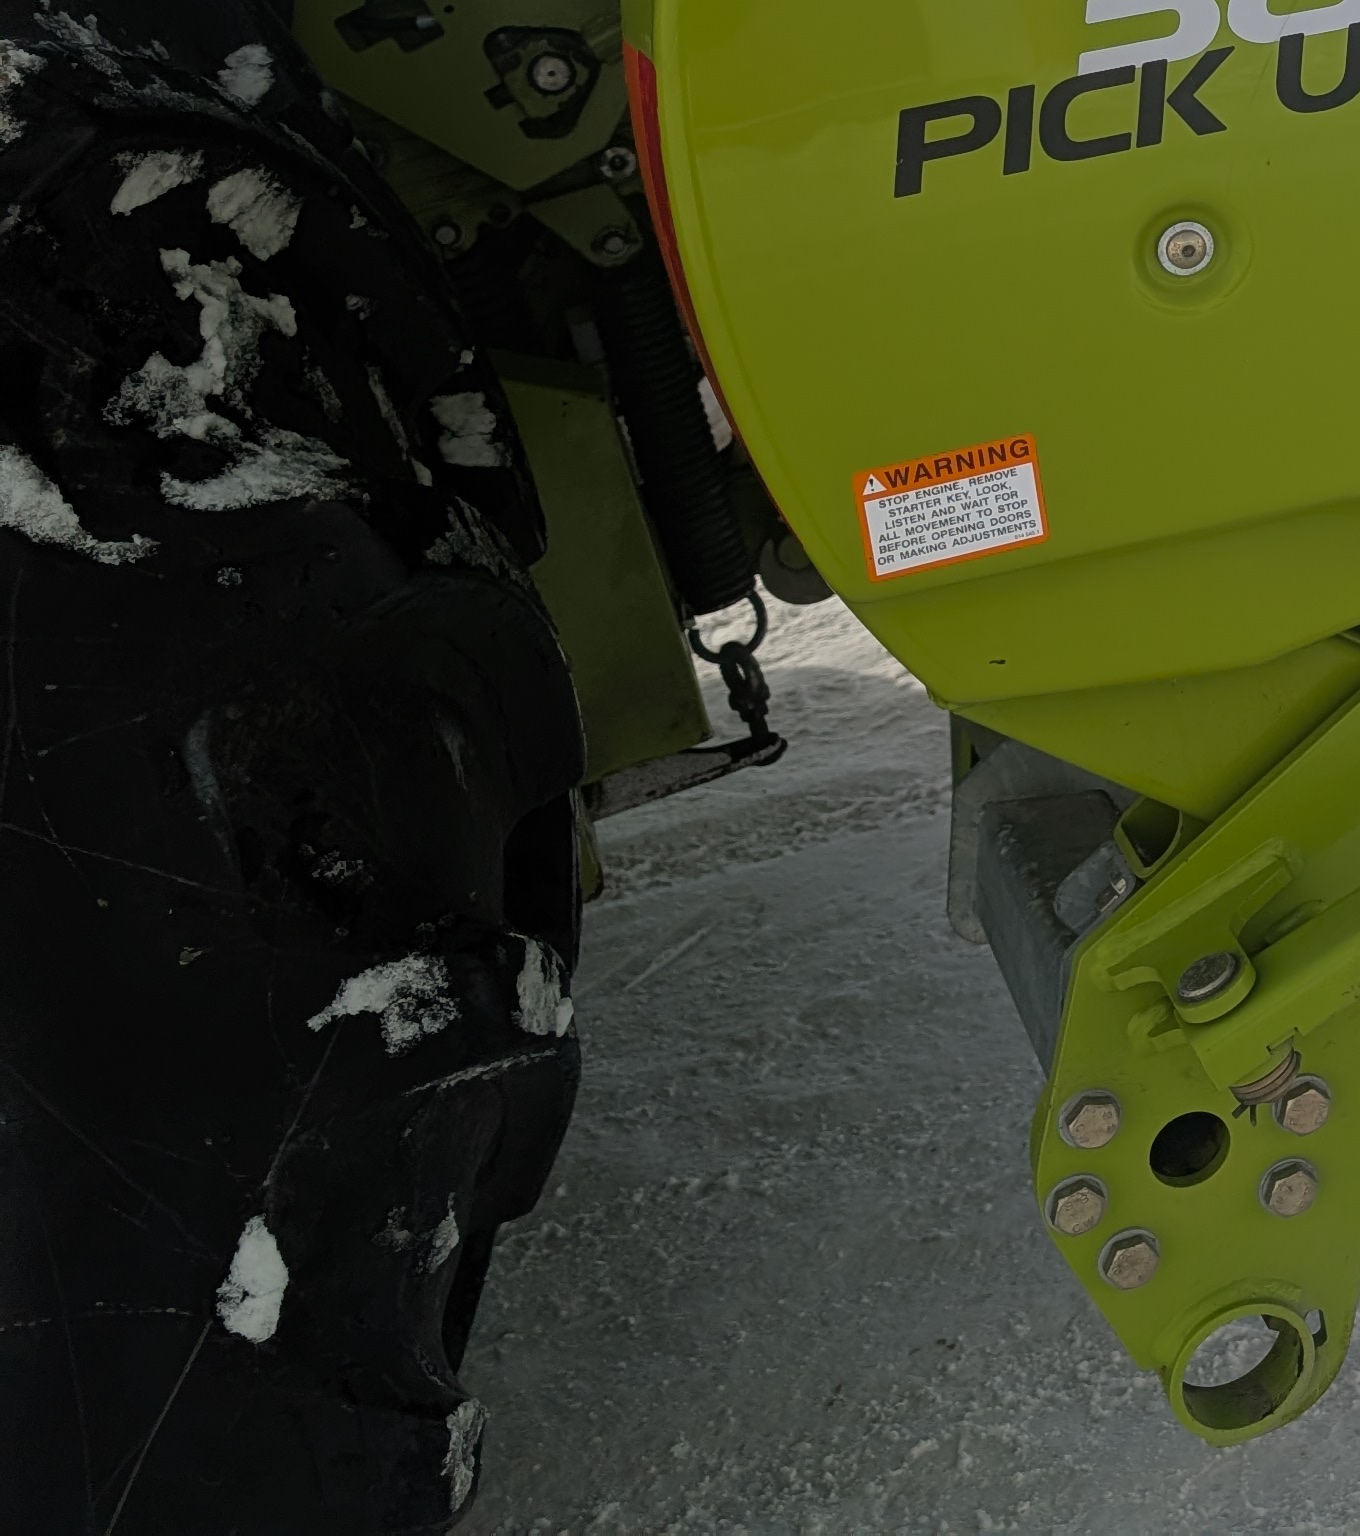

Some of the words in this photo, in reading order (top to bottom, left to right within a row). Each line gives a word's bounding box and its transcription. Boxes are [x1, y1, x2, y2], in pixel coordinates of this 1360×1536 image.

[894, 45, 1235, 198] PICK
[884, 439, 1030, 488] WARNING
[879, 495, 909, 509] STOP
[916, 482, 964, 499] ENGINE,
[969, 468, 1018, 487] REMOVE
[885, 513, 925, 530] LISTEN
[932, 506, 955, 519] AND
[961, 498, 989, 511] WAIT
[995, 491, 1018, 503] FOR
[889, 498, 941, 517] STARTER
[976, 482, 1012, 496] LOOK,
[878, 556, 895, 565] OR
[900, 542, 946, 560] MAKING
[952, 520, 1036, 547] ADJUSTMENTS
[879, 533, 899, 543] ALL
[906, 515, 971, 536] MOVEMENT
[977, 508, 992, 518] TO
[998, 499, 1028, 513] STOP
[880, 536, 926, 554] BEFORE
[932, 521, 985, 540] OPENING
[991, 510, 1031, 526] DOORS
